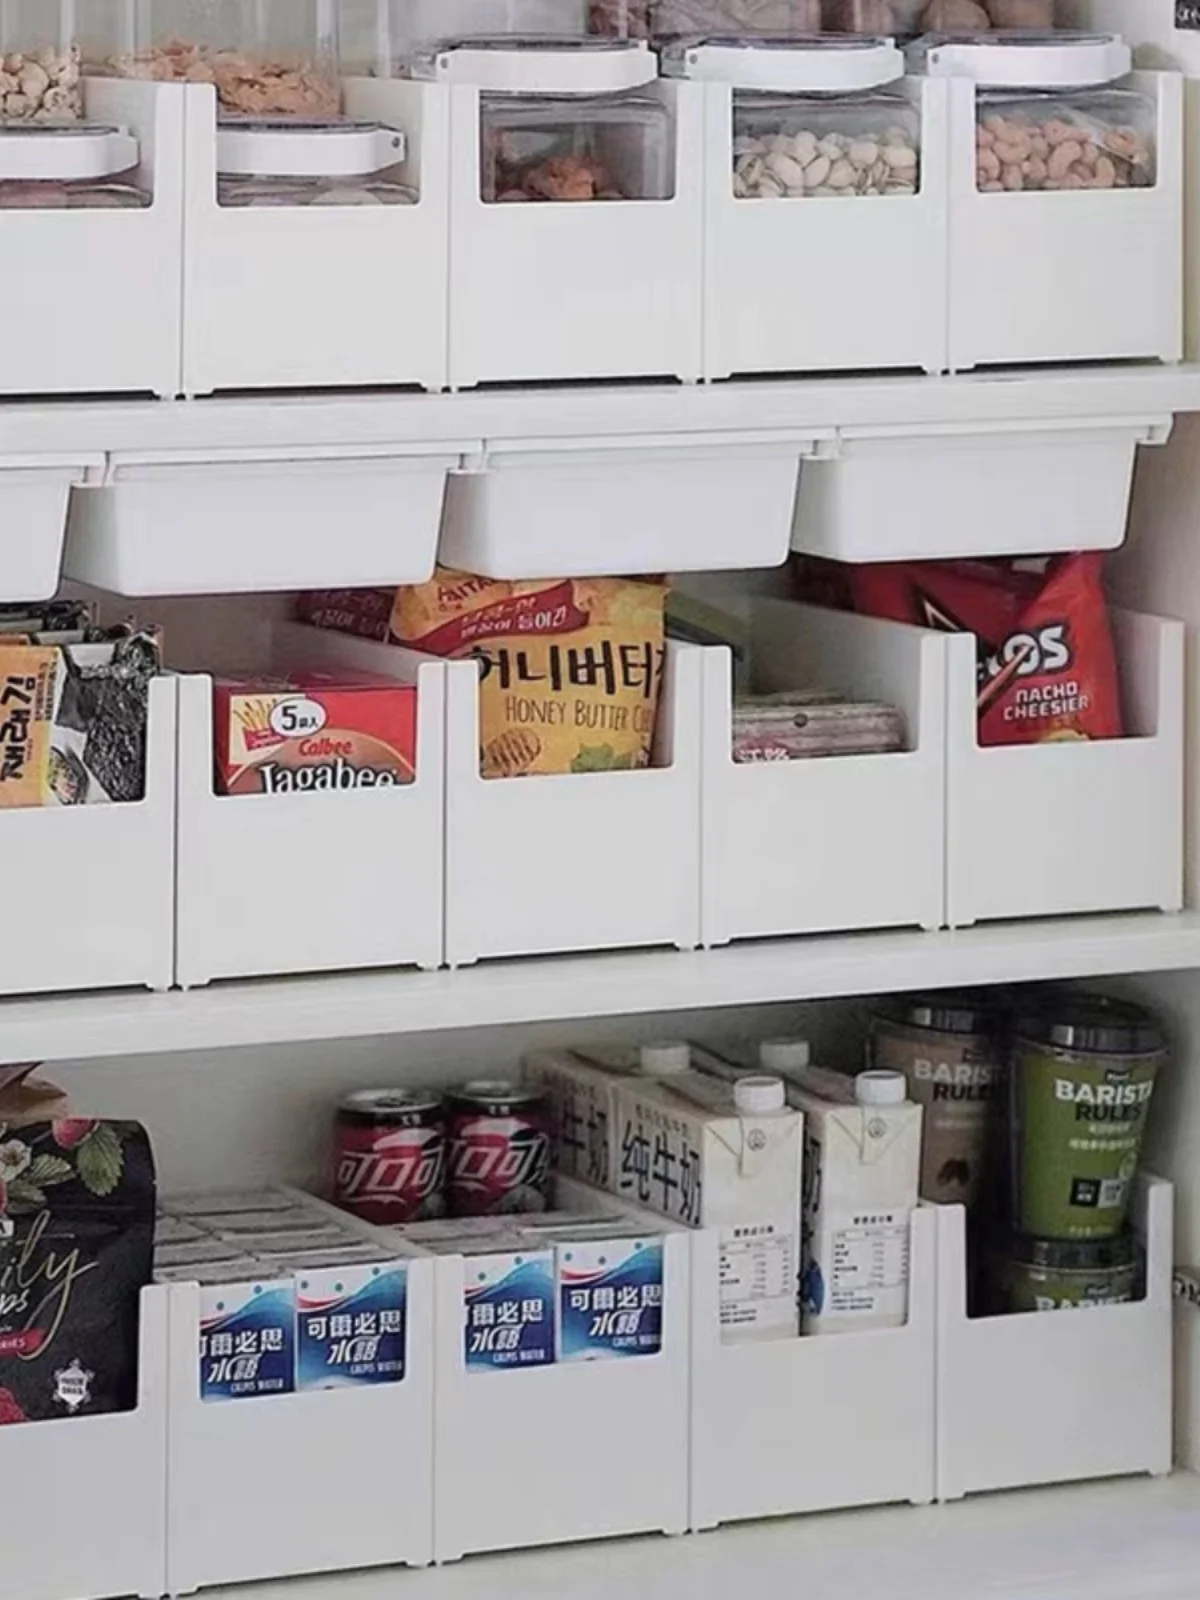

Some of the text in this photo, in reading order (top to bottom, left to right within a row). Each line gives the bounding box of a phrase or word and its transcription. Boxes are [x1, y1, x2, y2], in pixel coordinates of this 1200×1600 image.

[1016, 681, 1078, 704] NACHO
[505, 695, 566, 725] HONEY
[574, 699, 631, 732] BUTTER
[1003, 695, 1090, 721] CHEESIER
[299, 738, 353, 757] Calbee
